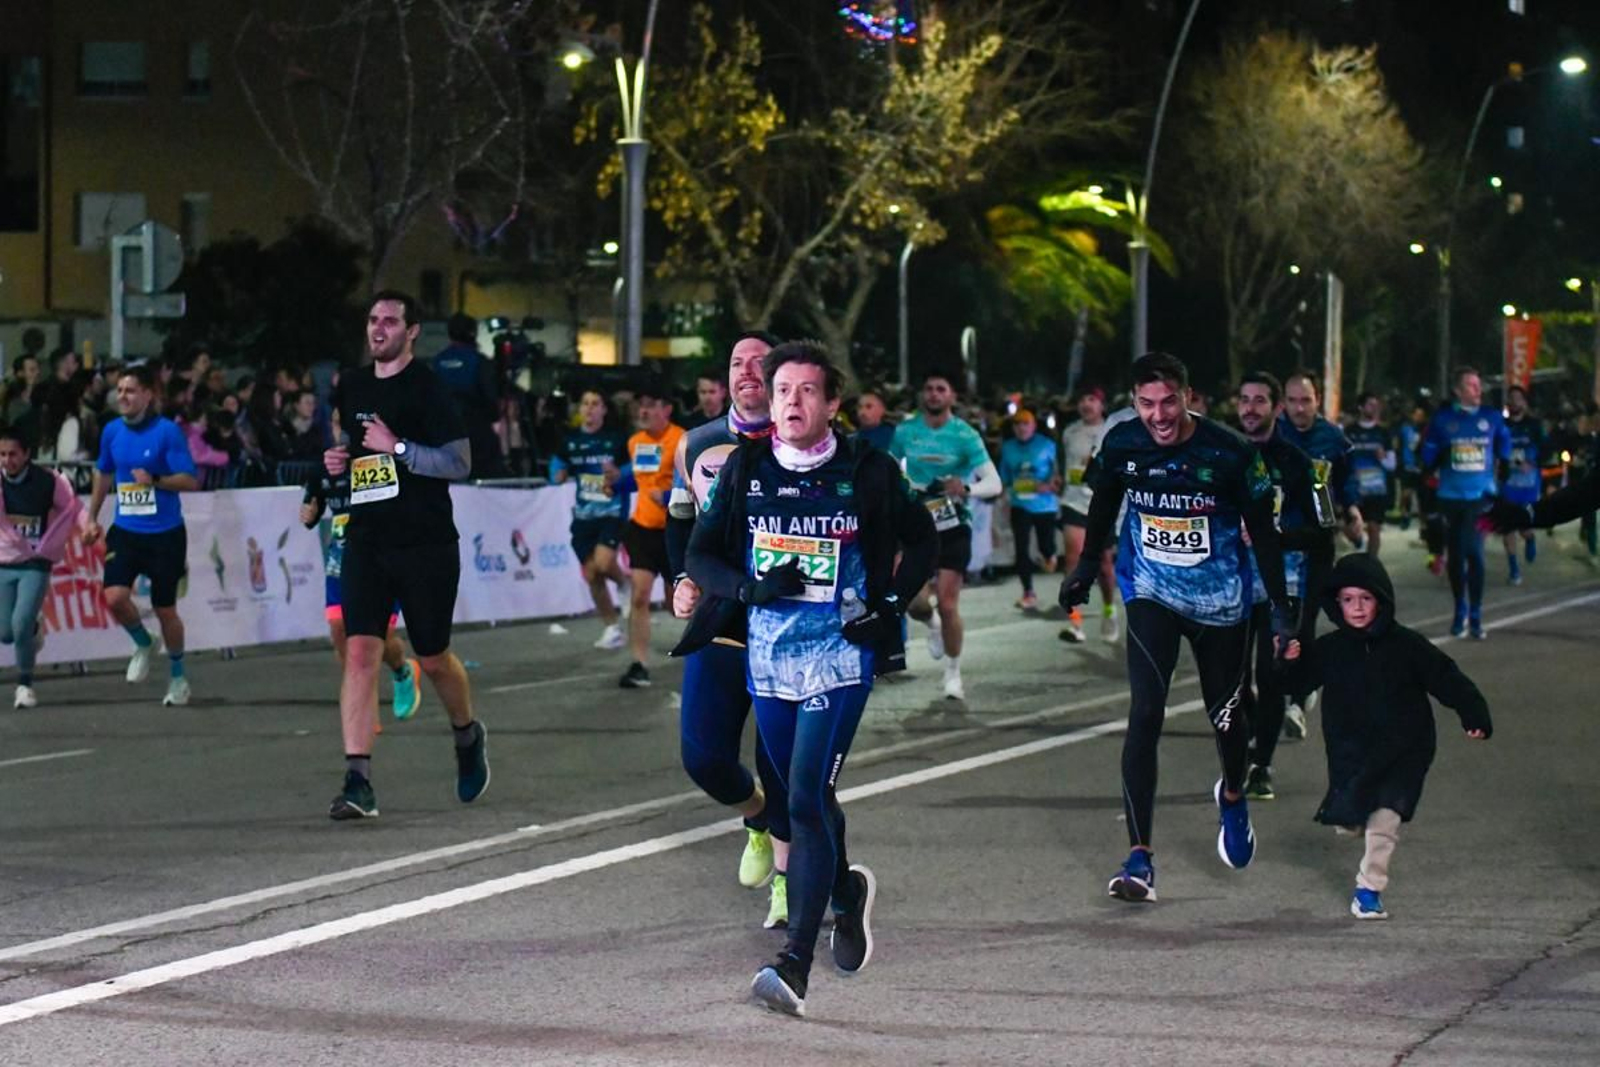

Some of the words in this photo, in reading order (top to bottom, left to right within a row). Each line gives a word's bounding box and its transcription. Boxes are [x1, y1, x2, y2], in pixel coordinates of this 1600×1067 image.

[353, 467, 391, 486] 3423
[1127, 488, 1154, 507] SAN
[1158, 492, 1216, 510] ANTÓN
[747, 515, 781, 534] SAN
[788, 511, 859, 534] ANTÓN
[770, 538, 785, 548] 42
[1147, 527, 1203, 547] 5849
